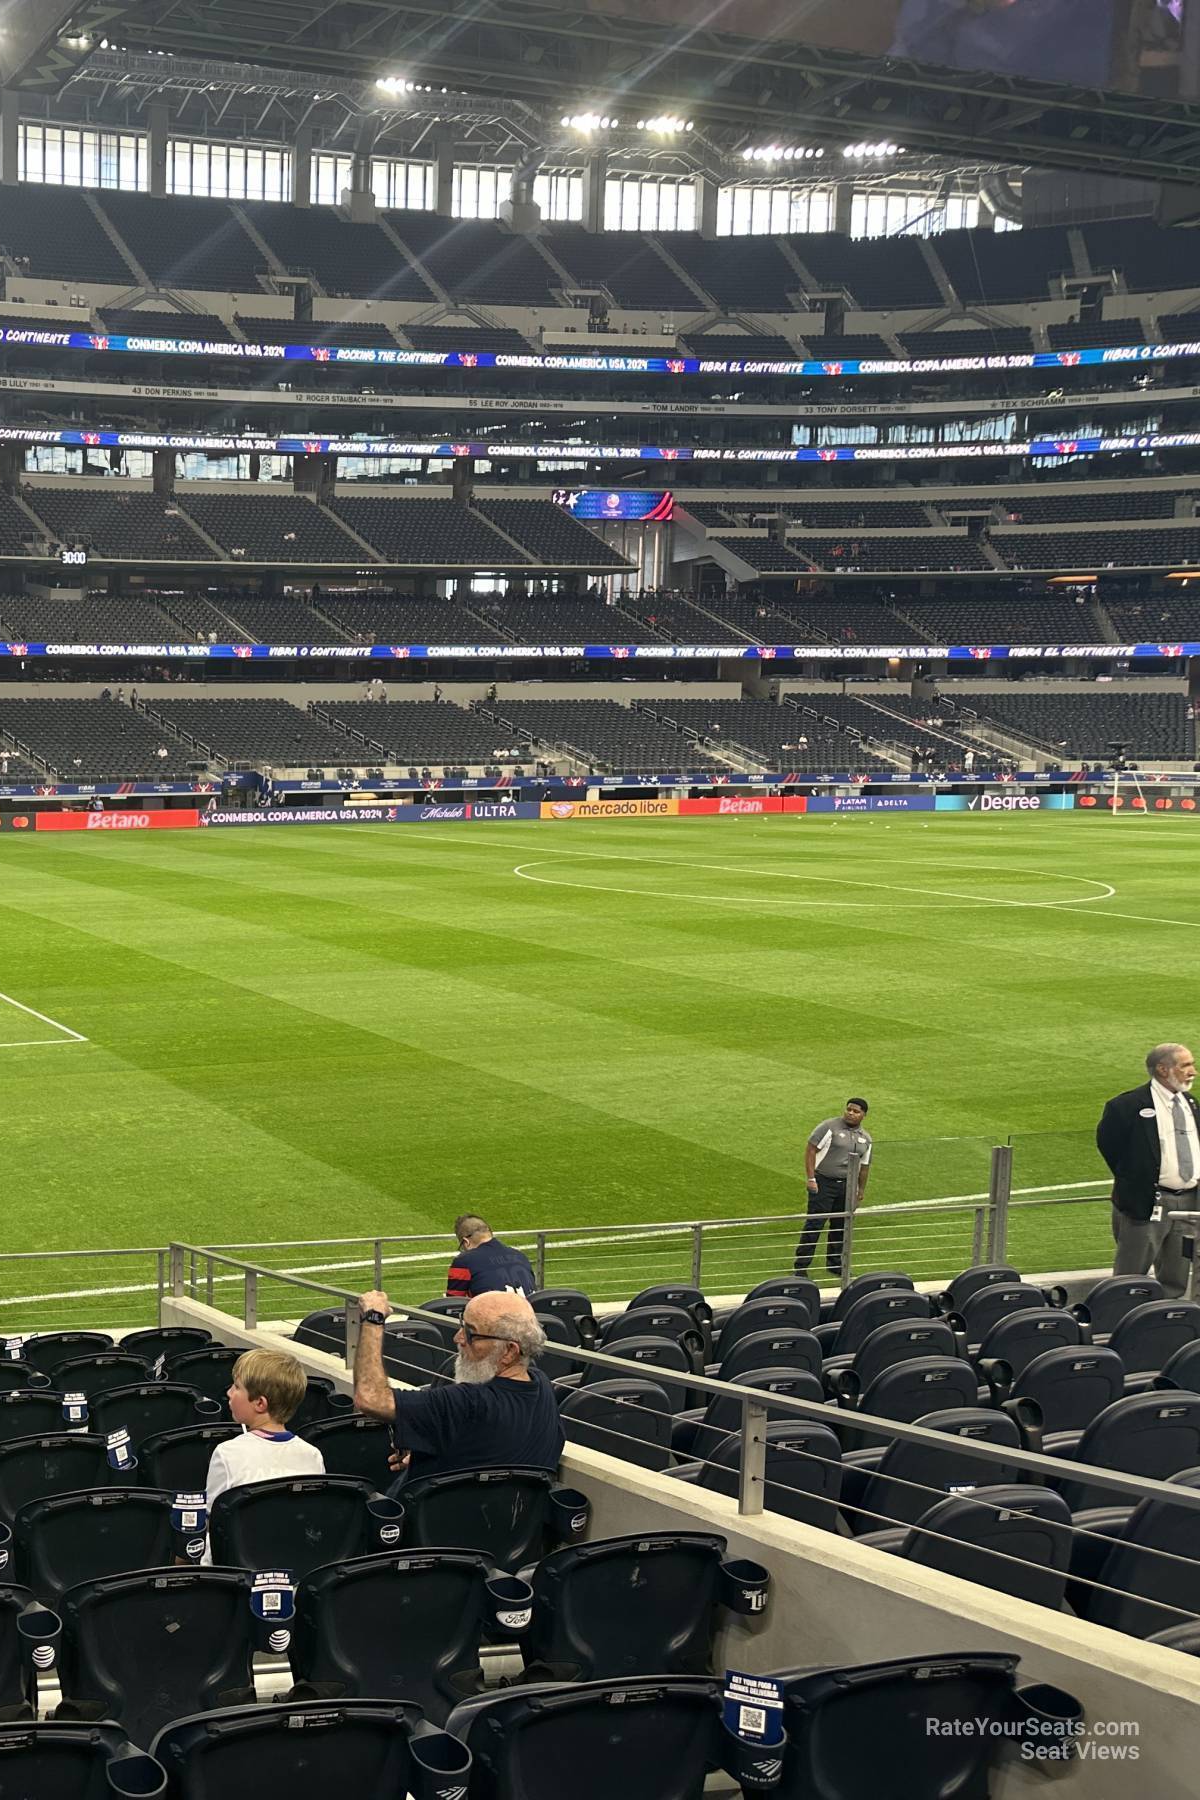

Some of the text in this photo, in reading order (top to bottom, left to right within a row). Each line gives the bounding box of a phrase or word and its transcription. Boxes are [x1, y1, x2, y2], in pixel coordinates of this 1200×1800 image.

[5, 330, 71, 345] CONTINENTE
[859, 355, 1034, 373] CONMEBOL COPA AMERICA USA 2024
[9, 380, 27, 388] LILLY
[145, 388, 160, 396] DON
[162, 388, 192, 397] PERKINS
[652, 404, 668, 412] TOM
[1001, 401, 1017, 409] TEX
[1020, 398, 1065, 407] SCHRAMM
[46, 645, 100, 655] CONMEBOL
[100, 645, 126, 656] COPA
[125, 645, 167, 656] AMERICA
[169, 646, 187, 656] USA
[269, 646, 372, 657] VIBRA O CONTINENTE
[578, 801, 668, 815] mercado libre
[981, 795, 1041, 811] Degree
[211, 808, 382, 823] CONMEBOL COPA AMERICA USA 2024
[420, 805, 516, 819] Michelob ULTRA
[87, 812, 149, 828] Betano
[504, 1613, 529, 1626] Ford
